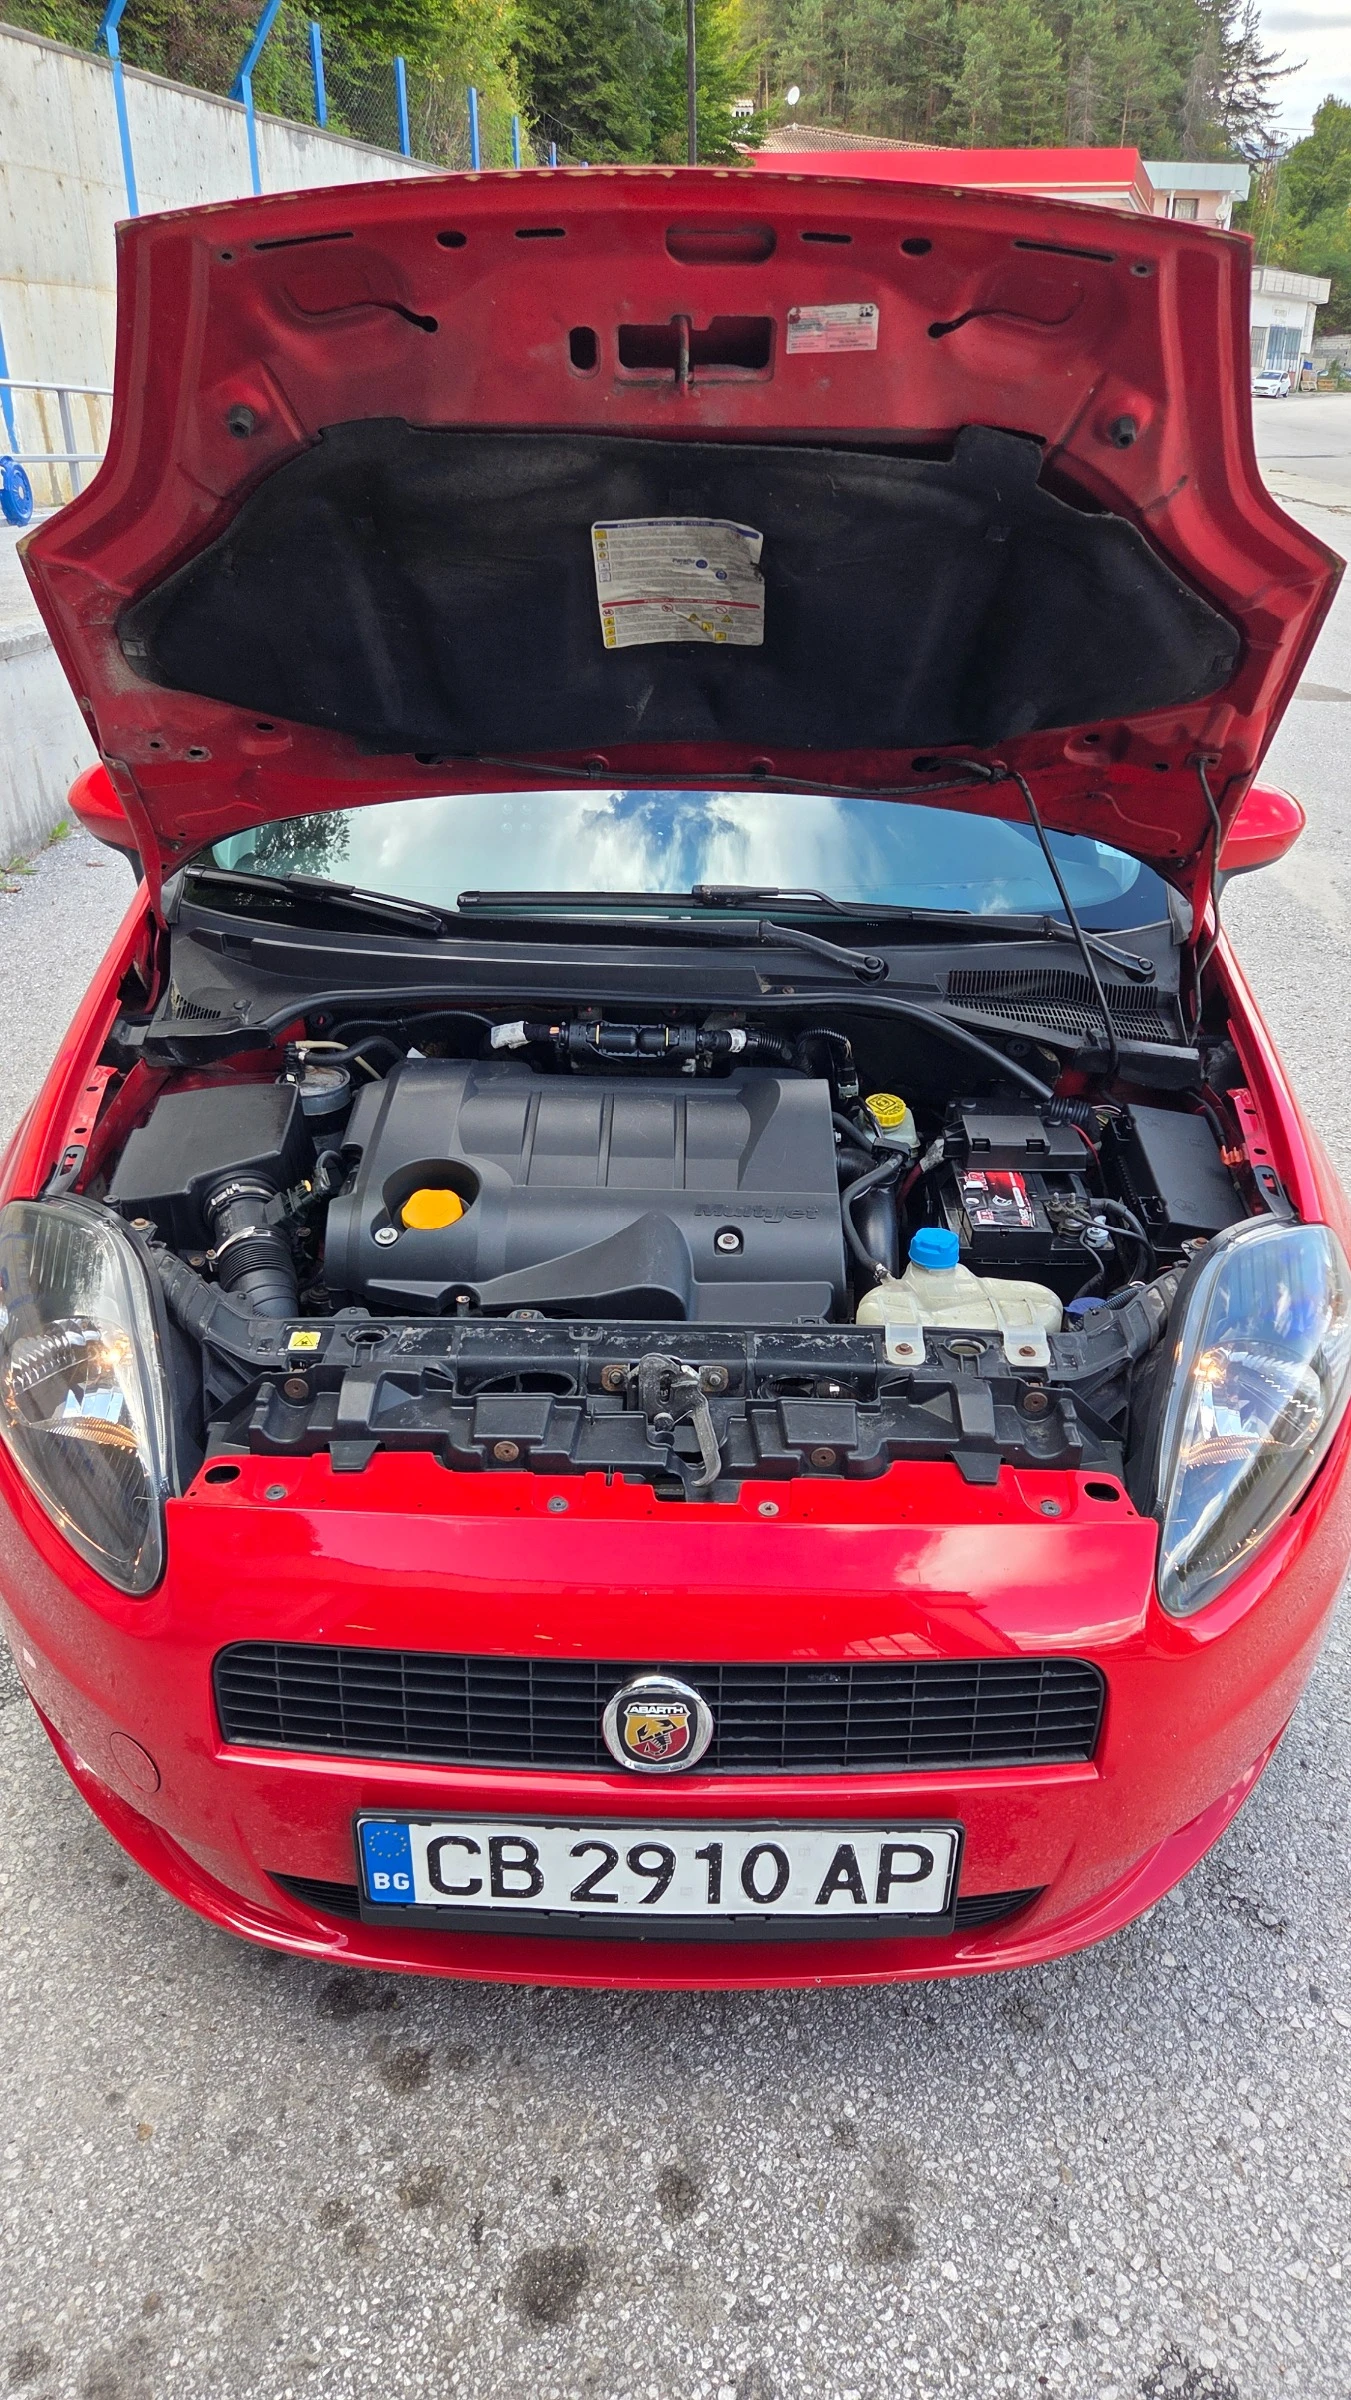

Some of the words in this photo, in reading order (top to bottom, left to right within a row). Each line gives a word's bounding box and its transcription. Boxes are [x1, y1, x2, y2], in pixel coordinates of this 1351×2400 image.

[629, 1706, 684, 1714] ABARTH
[427, 1835, 545, 1898] CB
[570, 1840, 790, 1904] 2910
[815, 1843, 935, 1905] AP
[373, 1872, 410, 1890] BG
